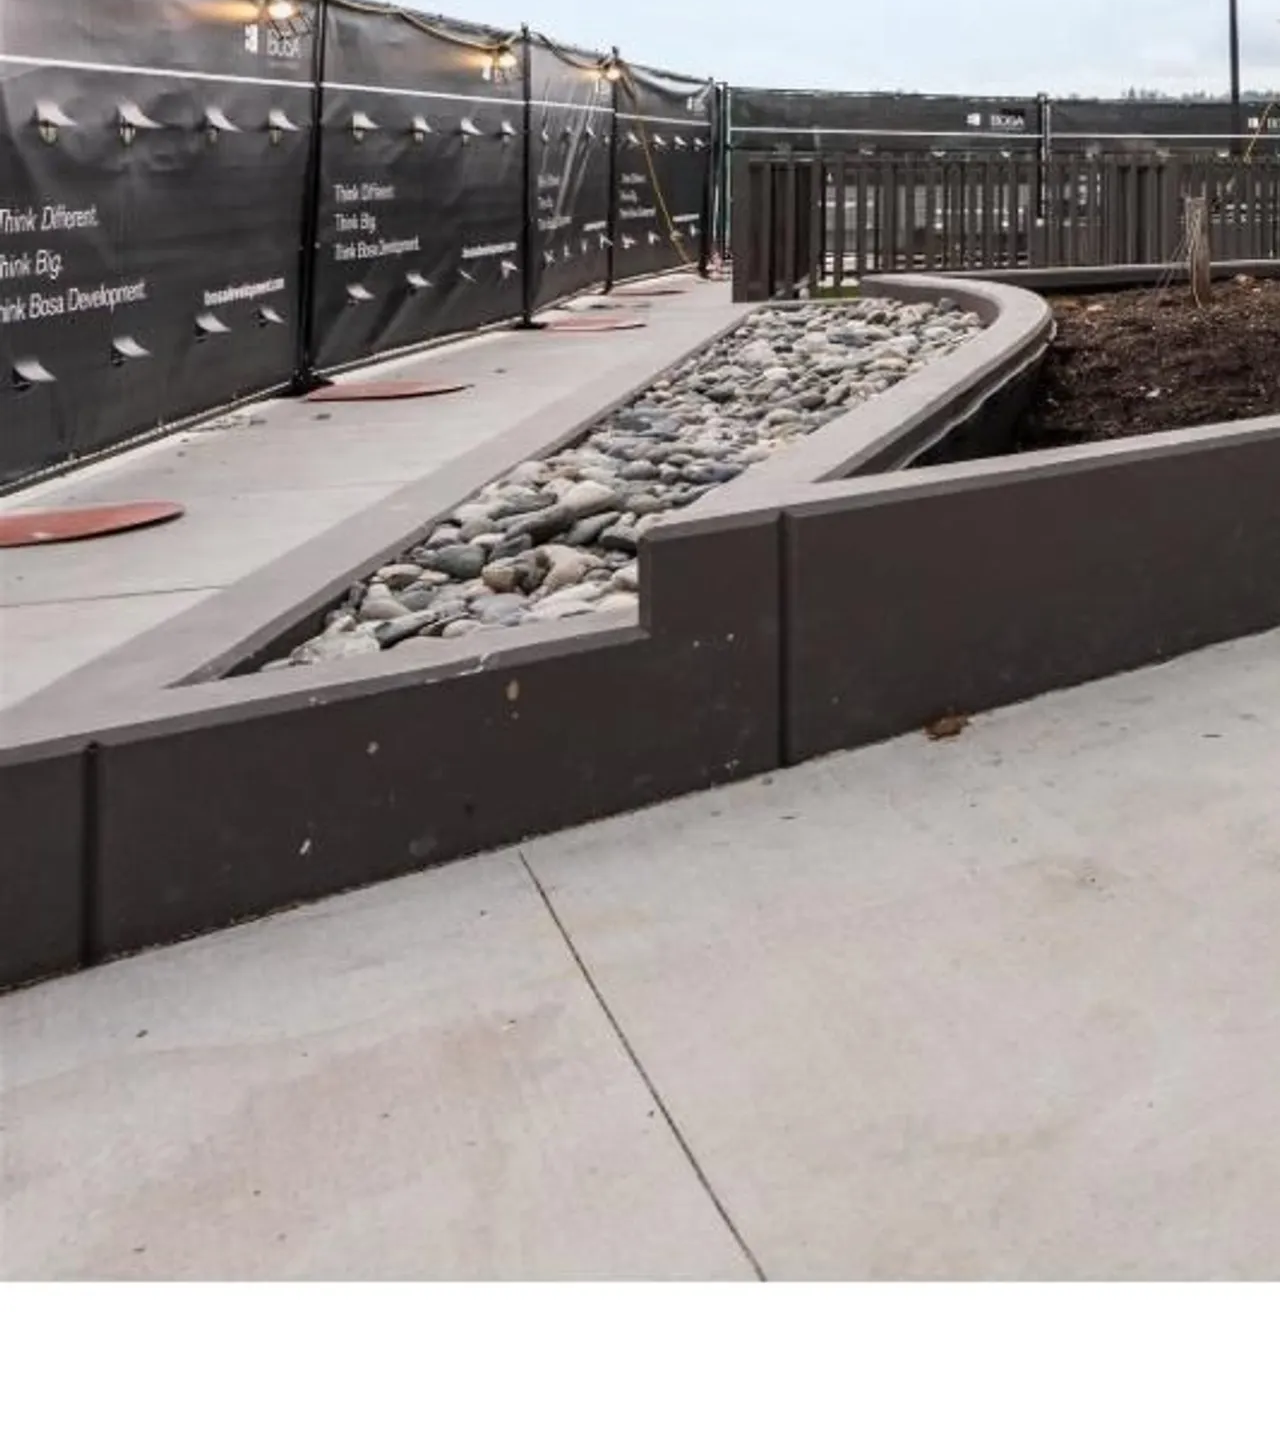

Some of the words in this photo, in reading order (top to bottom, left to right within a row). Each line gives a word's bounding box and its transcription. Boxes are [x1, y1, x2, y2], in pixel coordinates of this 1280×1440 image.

[0, 252, 31, 278] hink
[0, 296, 26, 323] ink
[29, 292, 65, 319] Bosa
